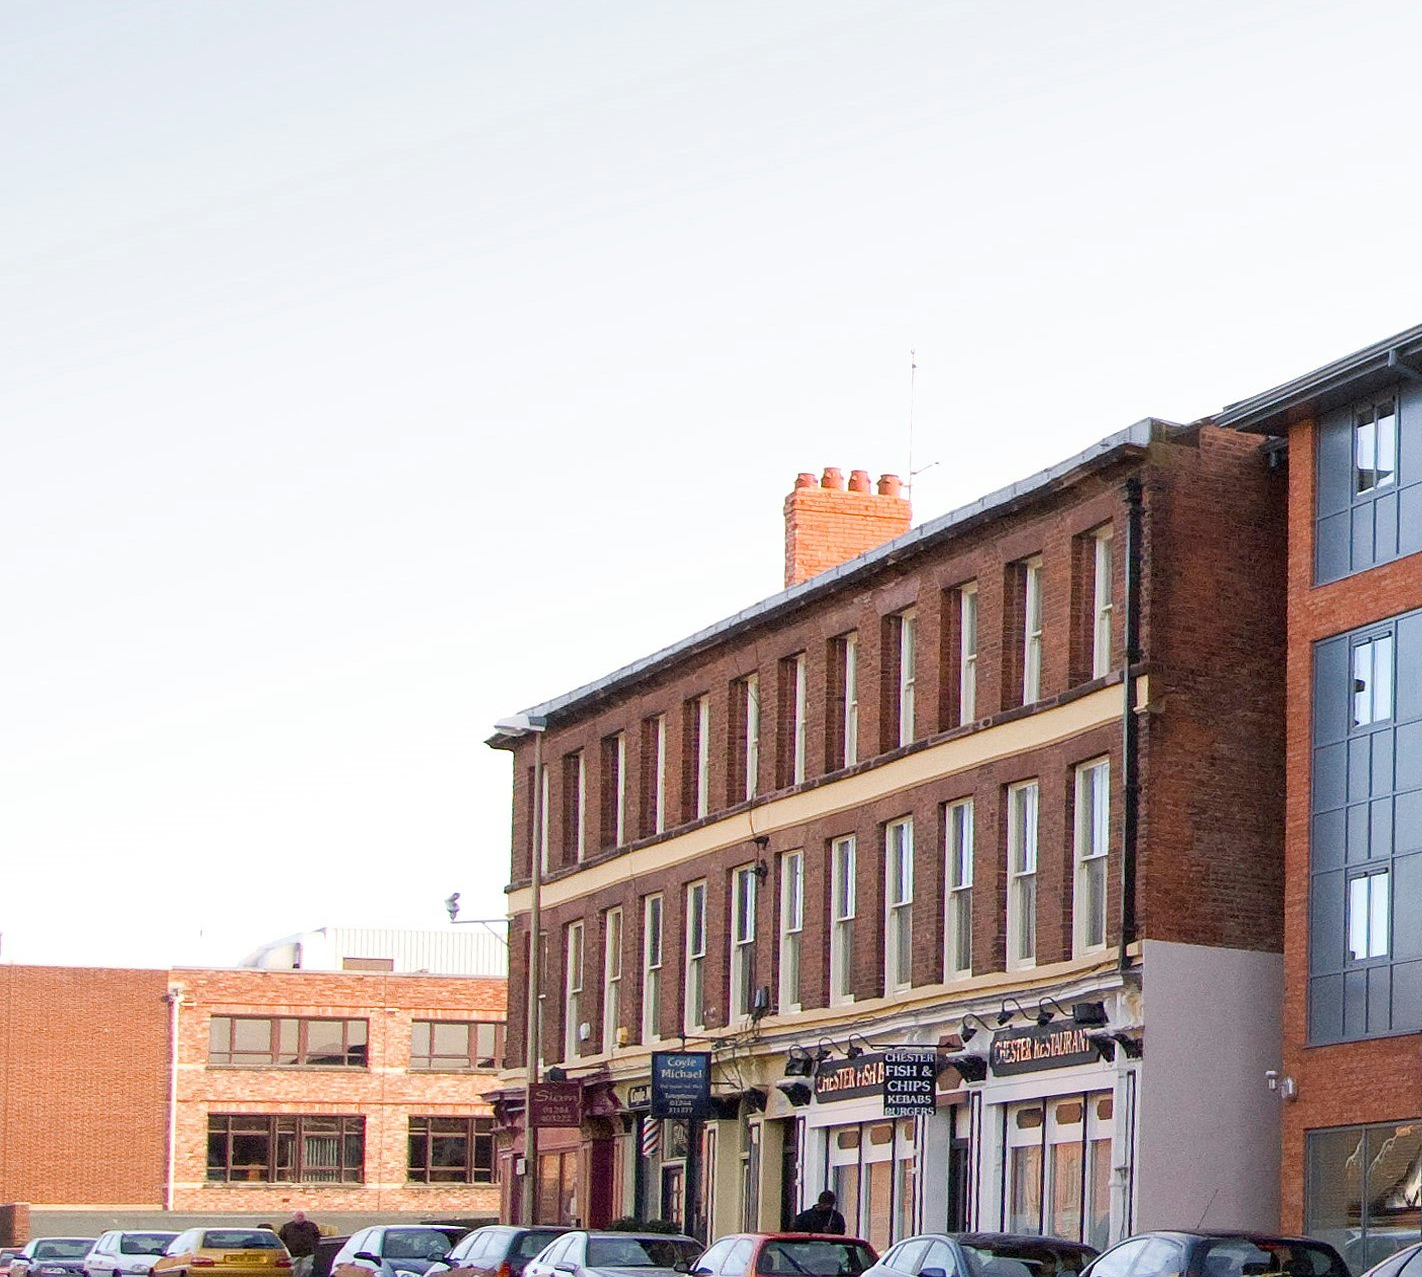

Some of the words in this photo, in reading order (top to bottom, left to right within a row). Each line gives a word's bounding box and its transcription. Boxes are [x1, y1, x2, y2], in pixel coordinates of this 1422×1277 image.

[885, 1053, 934, 1062] CHESTER
[661, 1069, 703, 1079] Michael
[885, 1065, 917, 1077] FISH
[921, 1065, 933, 1077] &
[817, 1067, 855, 1093] CHESTER
[887, 1080, 931, 1092] CHIPS
[887, 1095, 932, 1104] KEBABS
[885, 1107, 935, 1116] BURGERS
